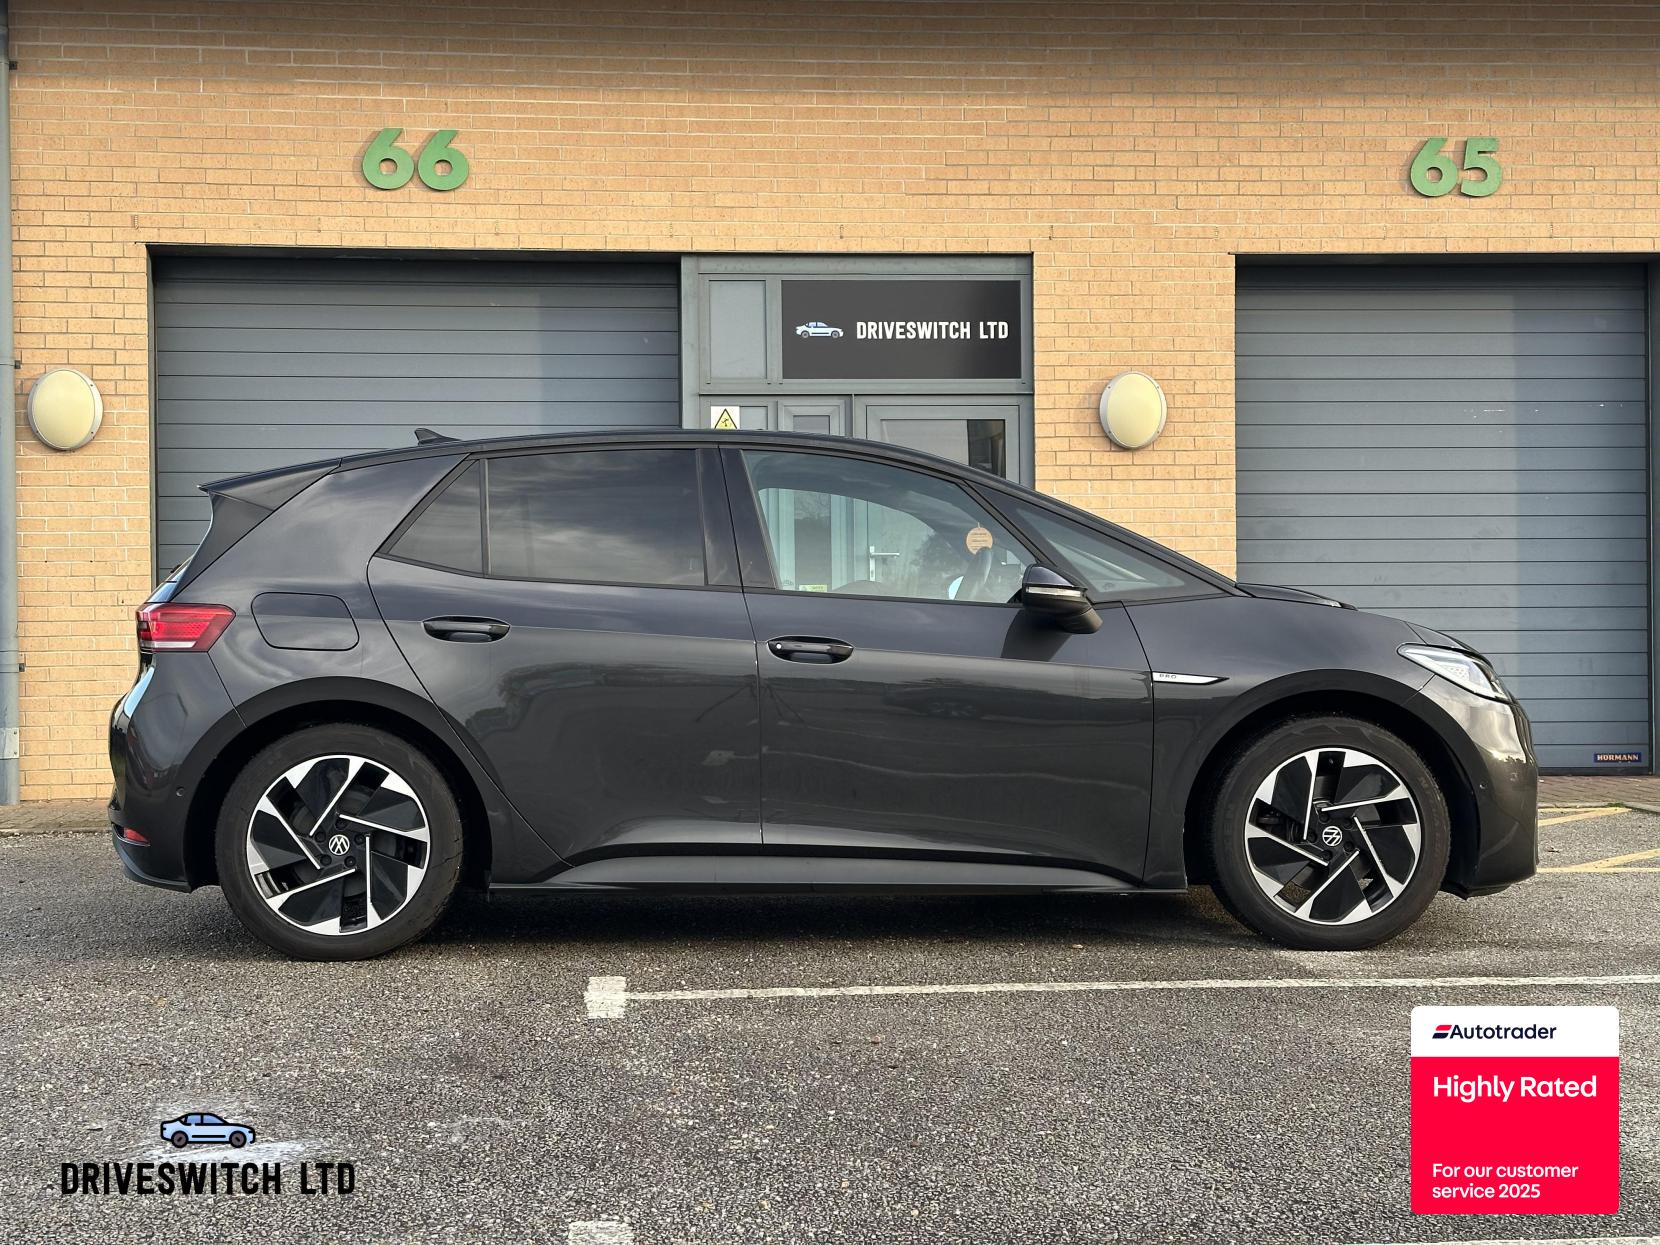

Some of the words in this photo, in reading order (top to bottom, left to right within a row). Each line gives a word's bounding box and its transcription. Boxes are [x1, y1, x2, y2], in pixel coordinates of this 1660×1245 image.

[362, 127, 469, 191] 66
[1410, 137, 1502, 197] 65
[856, 321, 971, 340] DRIVESWITCH
[979, 321, 1009, 340] LTD
